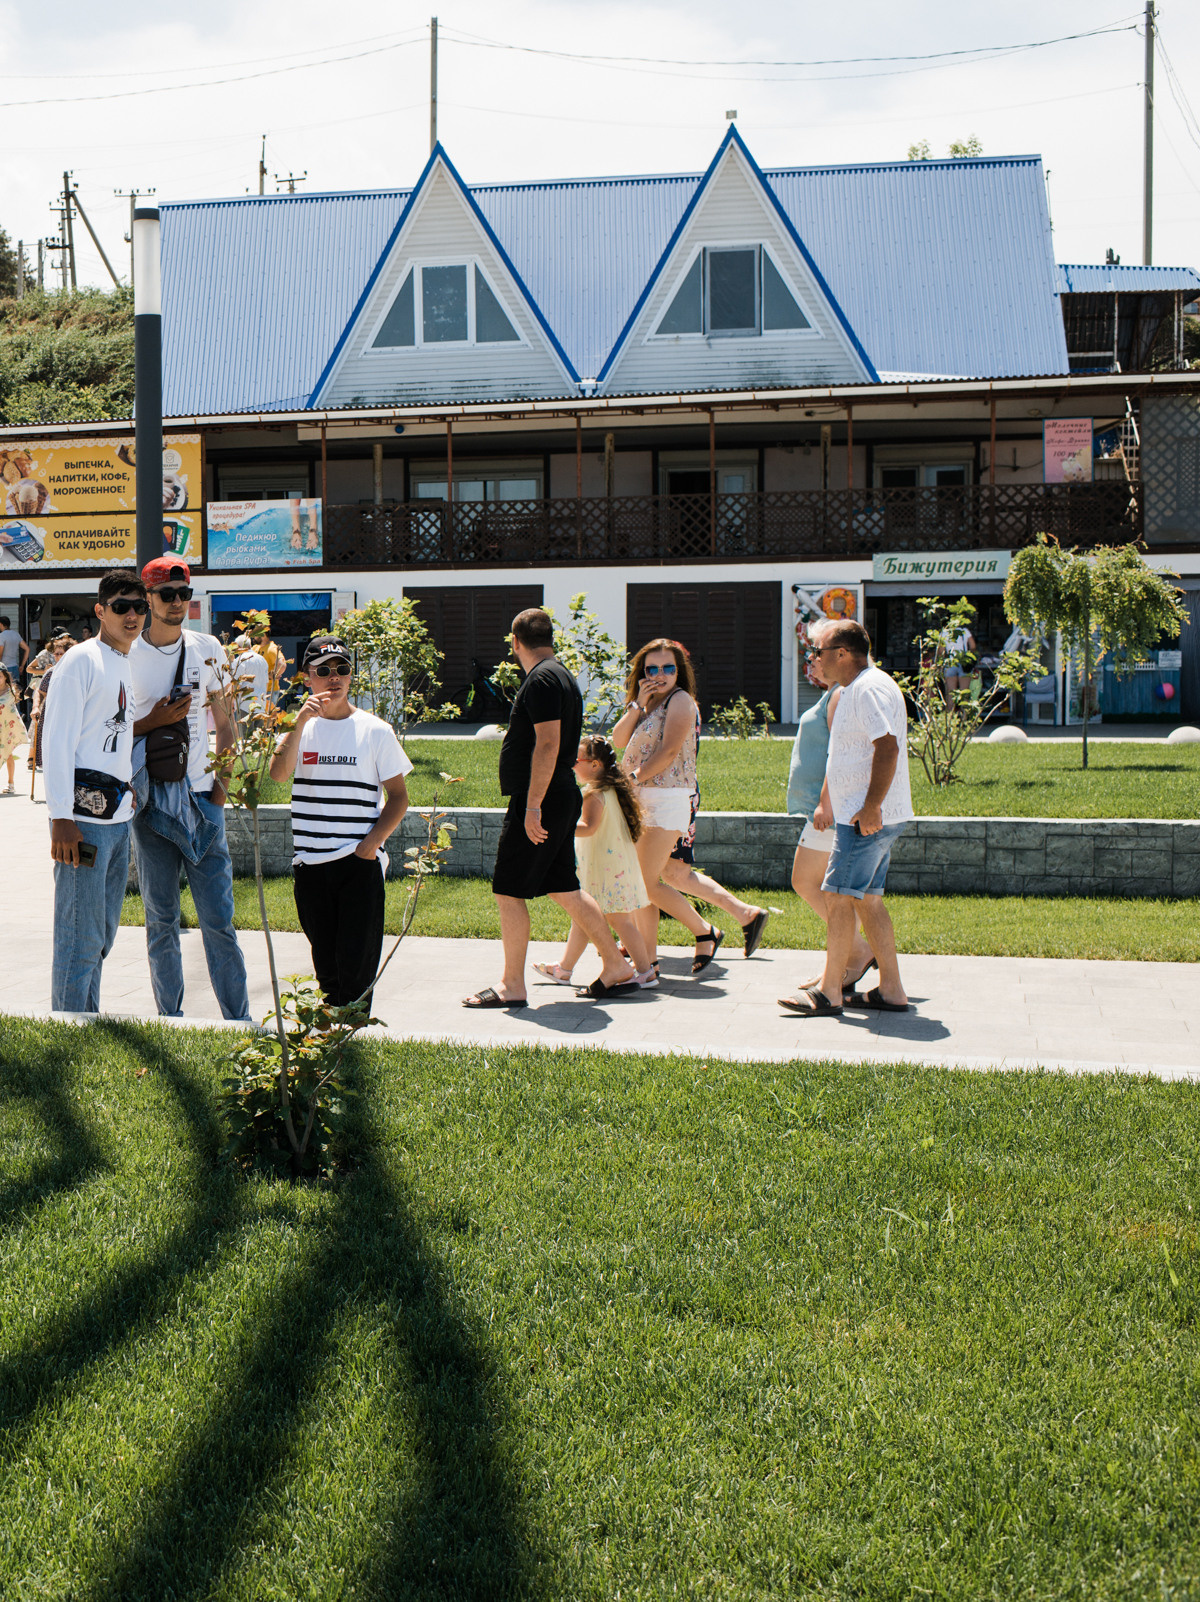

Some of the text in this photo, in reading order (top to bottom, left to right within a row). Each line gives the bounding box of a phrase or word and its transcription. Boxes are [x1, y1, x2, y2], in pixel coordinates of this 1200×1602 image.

[64, 460, 114, 469] ВЫПЕЧКА,
[48, 472, 131, 483] НАПИТКИ, КОФЕ,
[53, 486, 126, 495] МОРОЖЕННОЕ!
[244, 502, 256, 510] SPA
[212, 511, 245, 520] процедура!
[53, 526, 131, 539] ОПЛАЧИВАЙТЕ
[235, 533, 277, 542] Педикюр
[58, 540, 126, 551] КАК УДОБНО
[226, 546, 267, 555] рыбками
[883, 557, 998, 578] Бижутерия
[319, 644, 343, 654] FILA
